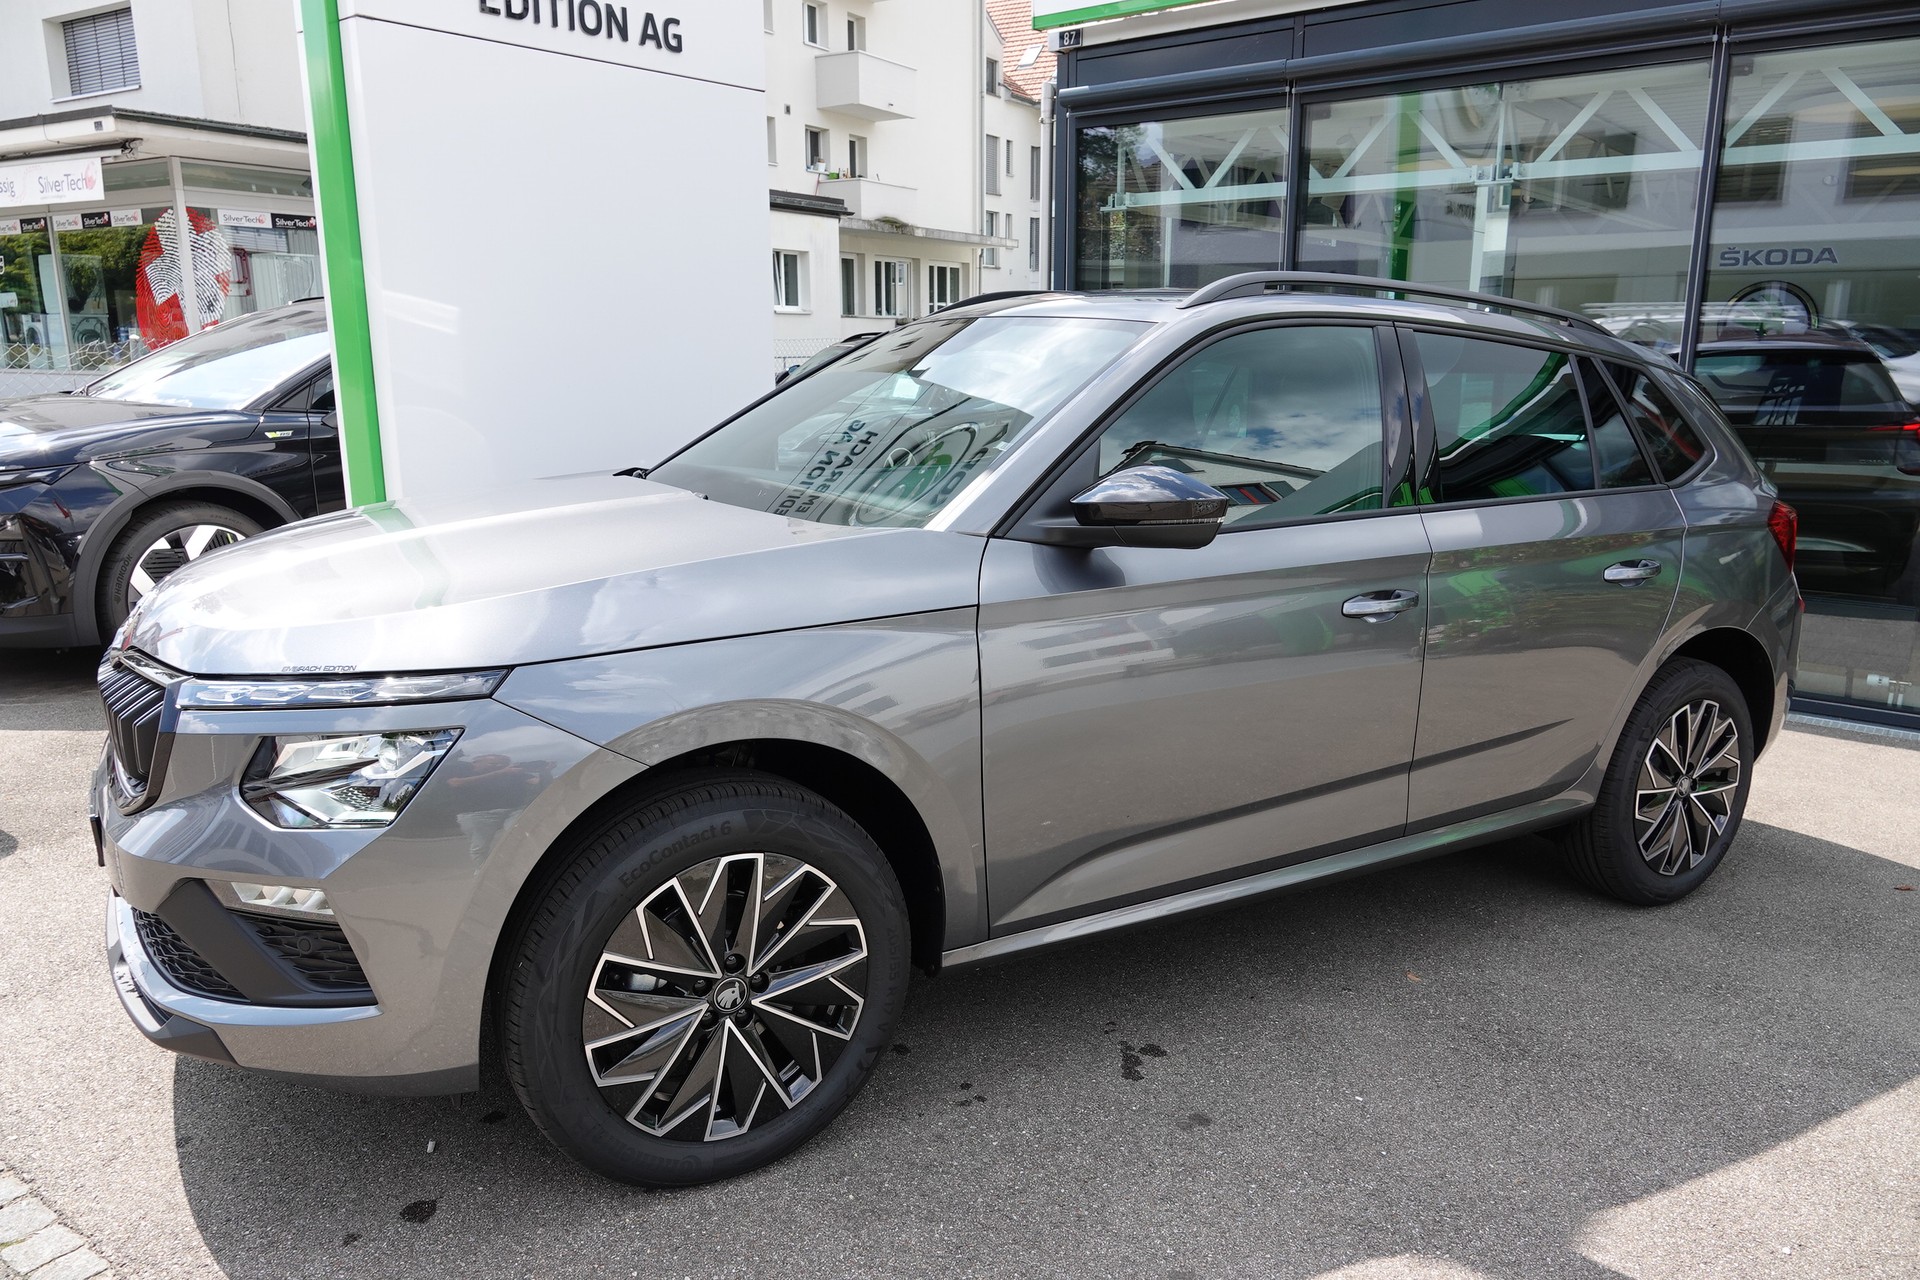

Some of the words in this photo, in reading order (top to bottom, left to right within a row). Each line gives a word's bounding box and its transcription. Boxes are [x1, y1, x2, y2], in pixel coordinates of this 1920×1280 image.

[639, 12, 683, 53] AG
[1063, 31, 1076, 46] 87
[1719, 246, 1838, 267] ŠKODA
[322, 664, 357, 672] EDITION
[618, 823, 718, 888] EcoContact
[720, 820, 732, 836] 6
